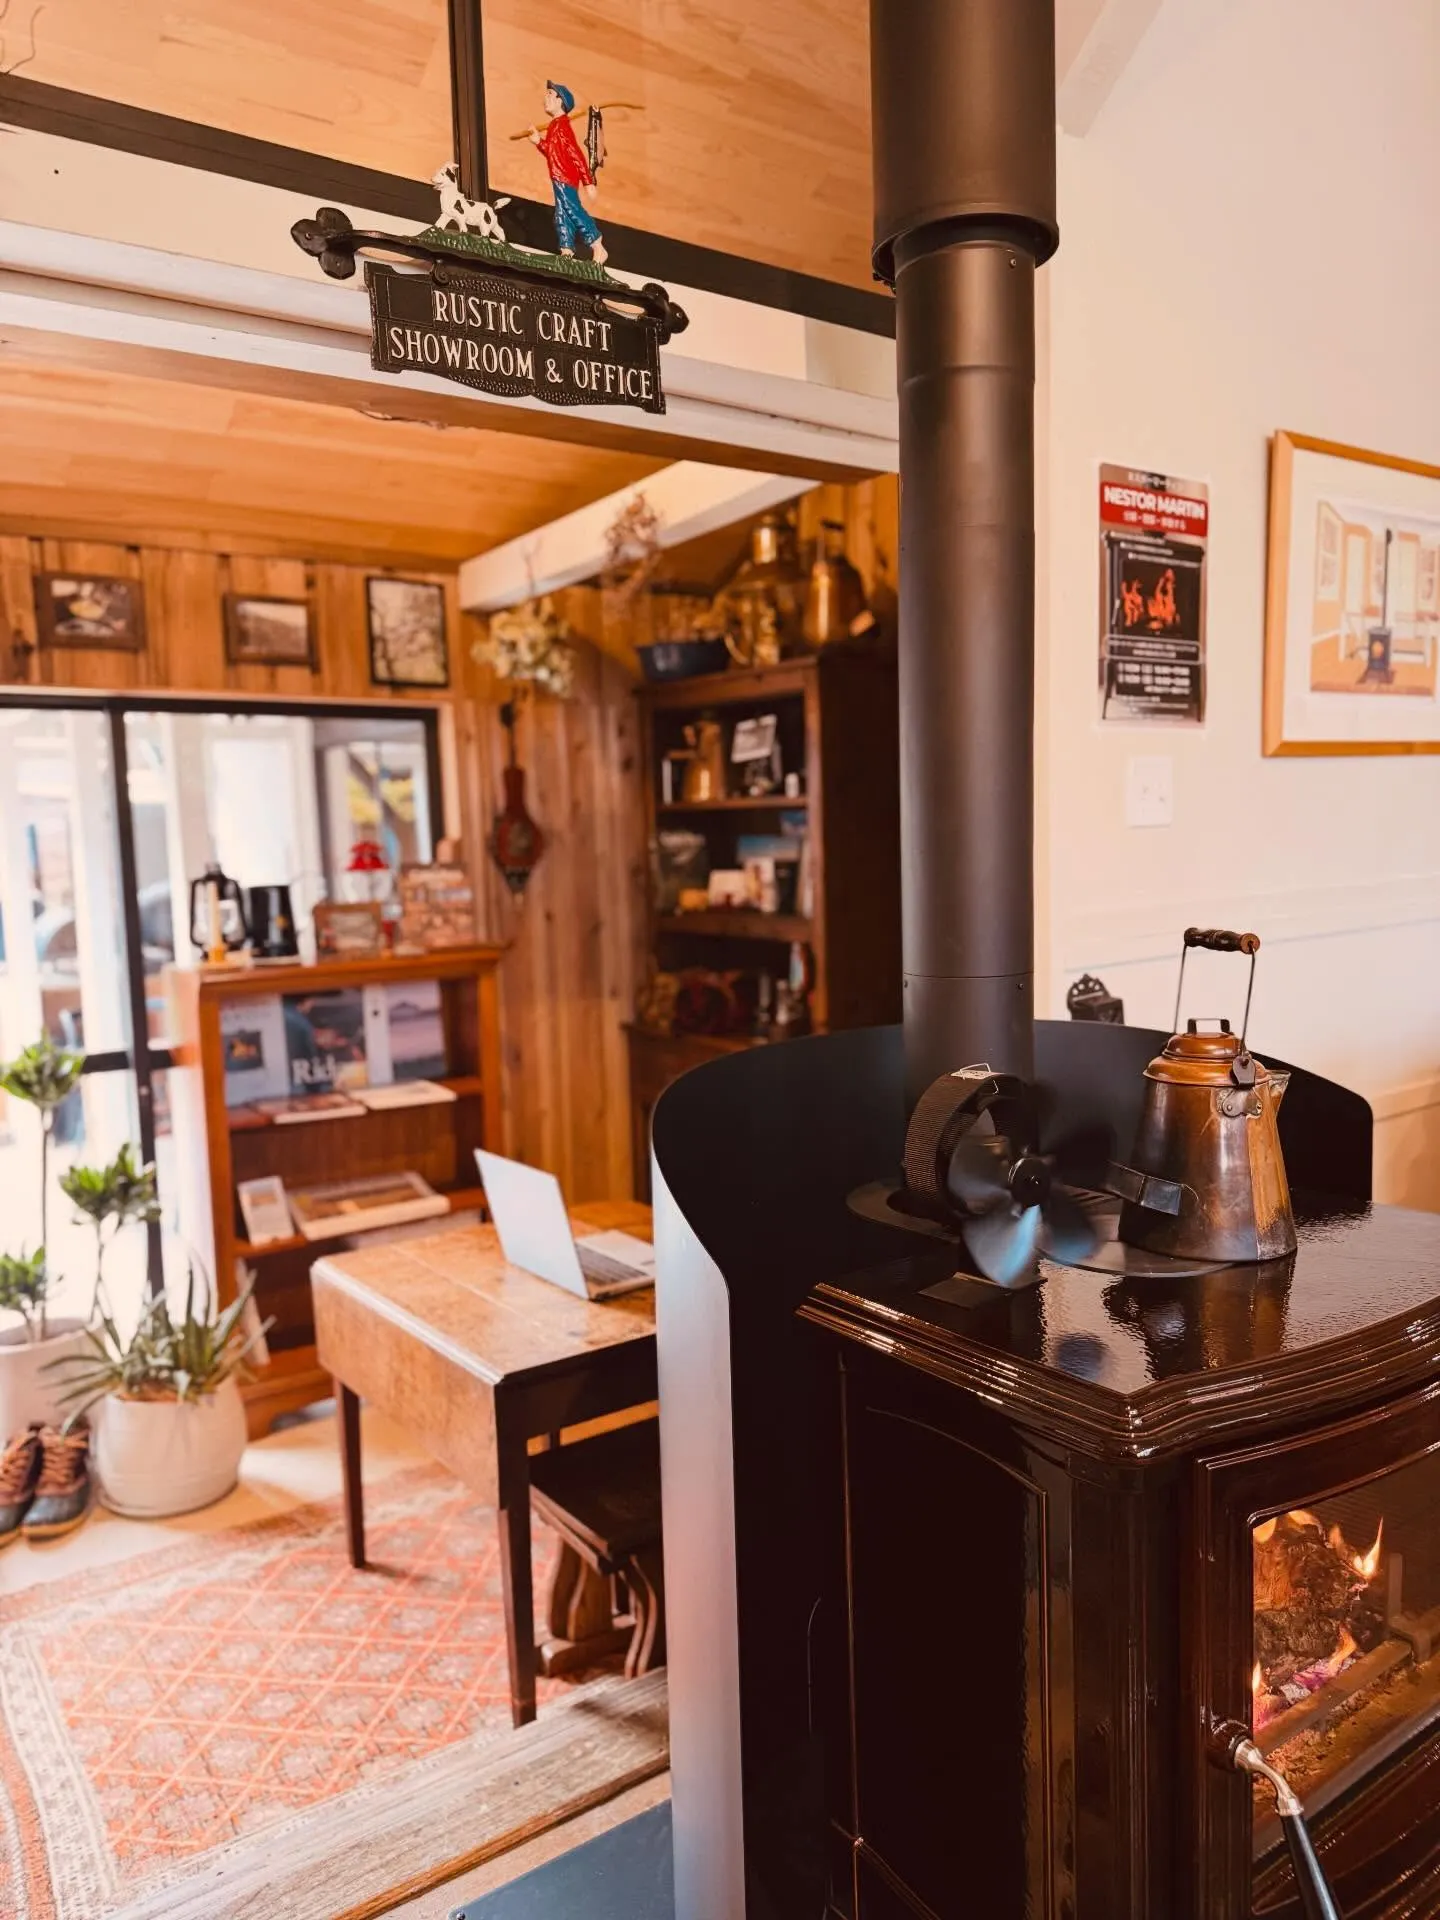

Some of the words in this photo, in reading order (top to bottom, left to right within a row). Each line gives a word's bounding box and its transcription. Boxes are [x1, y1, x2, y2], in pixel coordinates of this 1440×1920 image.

[433, 290, 524, 335] RUSTIC
[538, 311, 611, 351] CRAFT
[390, 327, 535, 380] SHOWROOM
[546, 358, 563, 384] &
[573, 359, 653, 400] OFFICE
[1104, 485, 1156, 511] NESTOR
[1157, 495, 1205, 520] MARTIN
